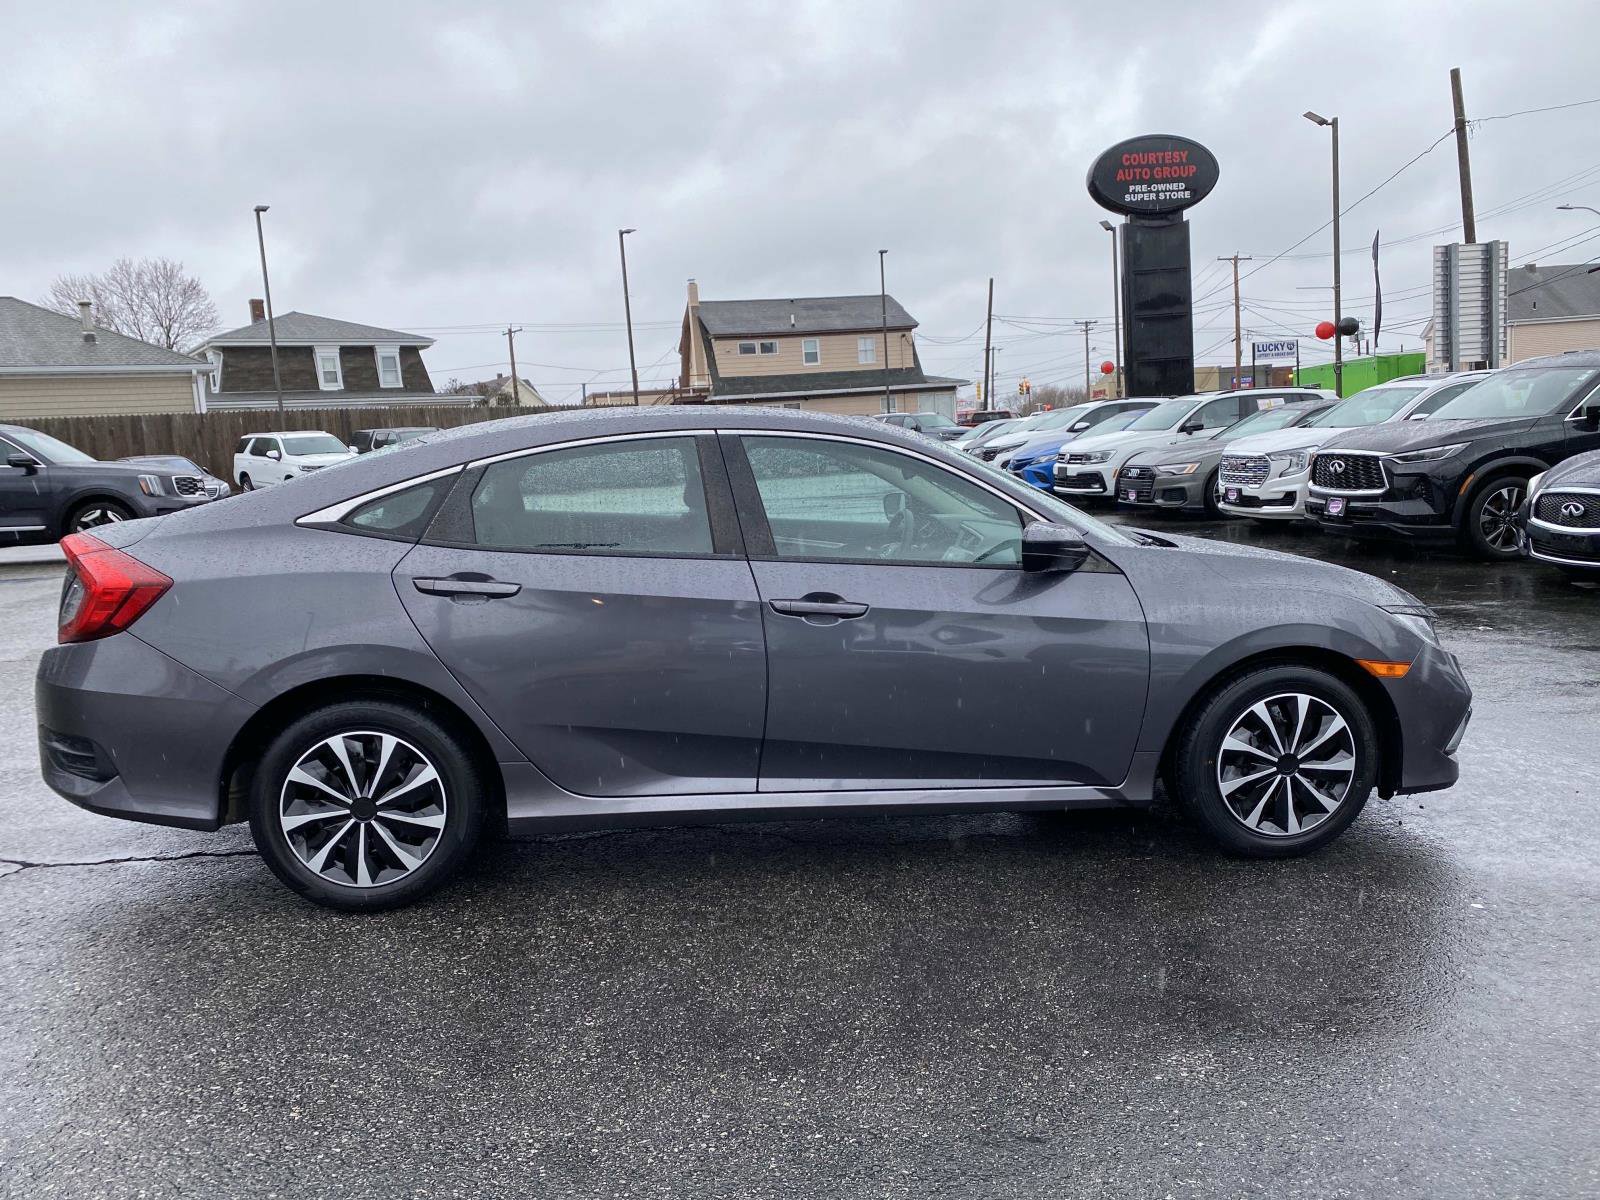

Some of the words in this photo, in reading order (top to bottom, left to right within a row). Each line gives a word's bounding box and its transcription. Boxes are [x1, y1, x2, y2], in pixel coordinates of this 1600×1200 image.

[1122, 151, 1188, 165] COURTESY
[1116, 168, 1150, 181] AUTO
[1154, 165, 1197, 178] GROUP
[1129, 183, 1185, 192] PRE-OWNED
[1125, 193, 1156, 202] SUPER
[1158, 191, 1191, 200] STORE
[1257, 342, 1285, 352] LUCKY
